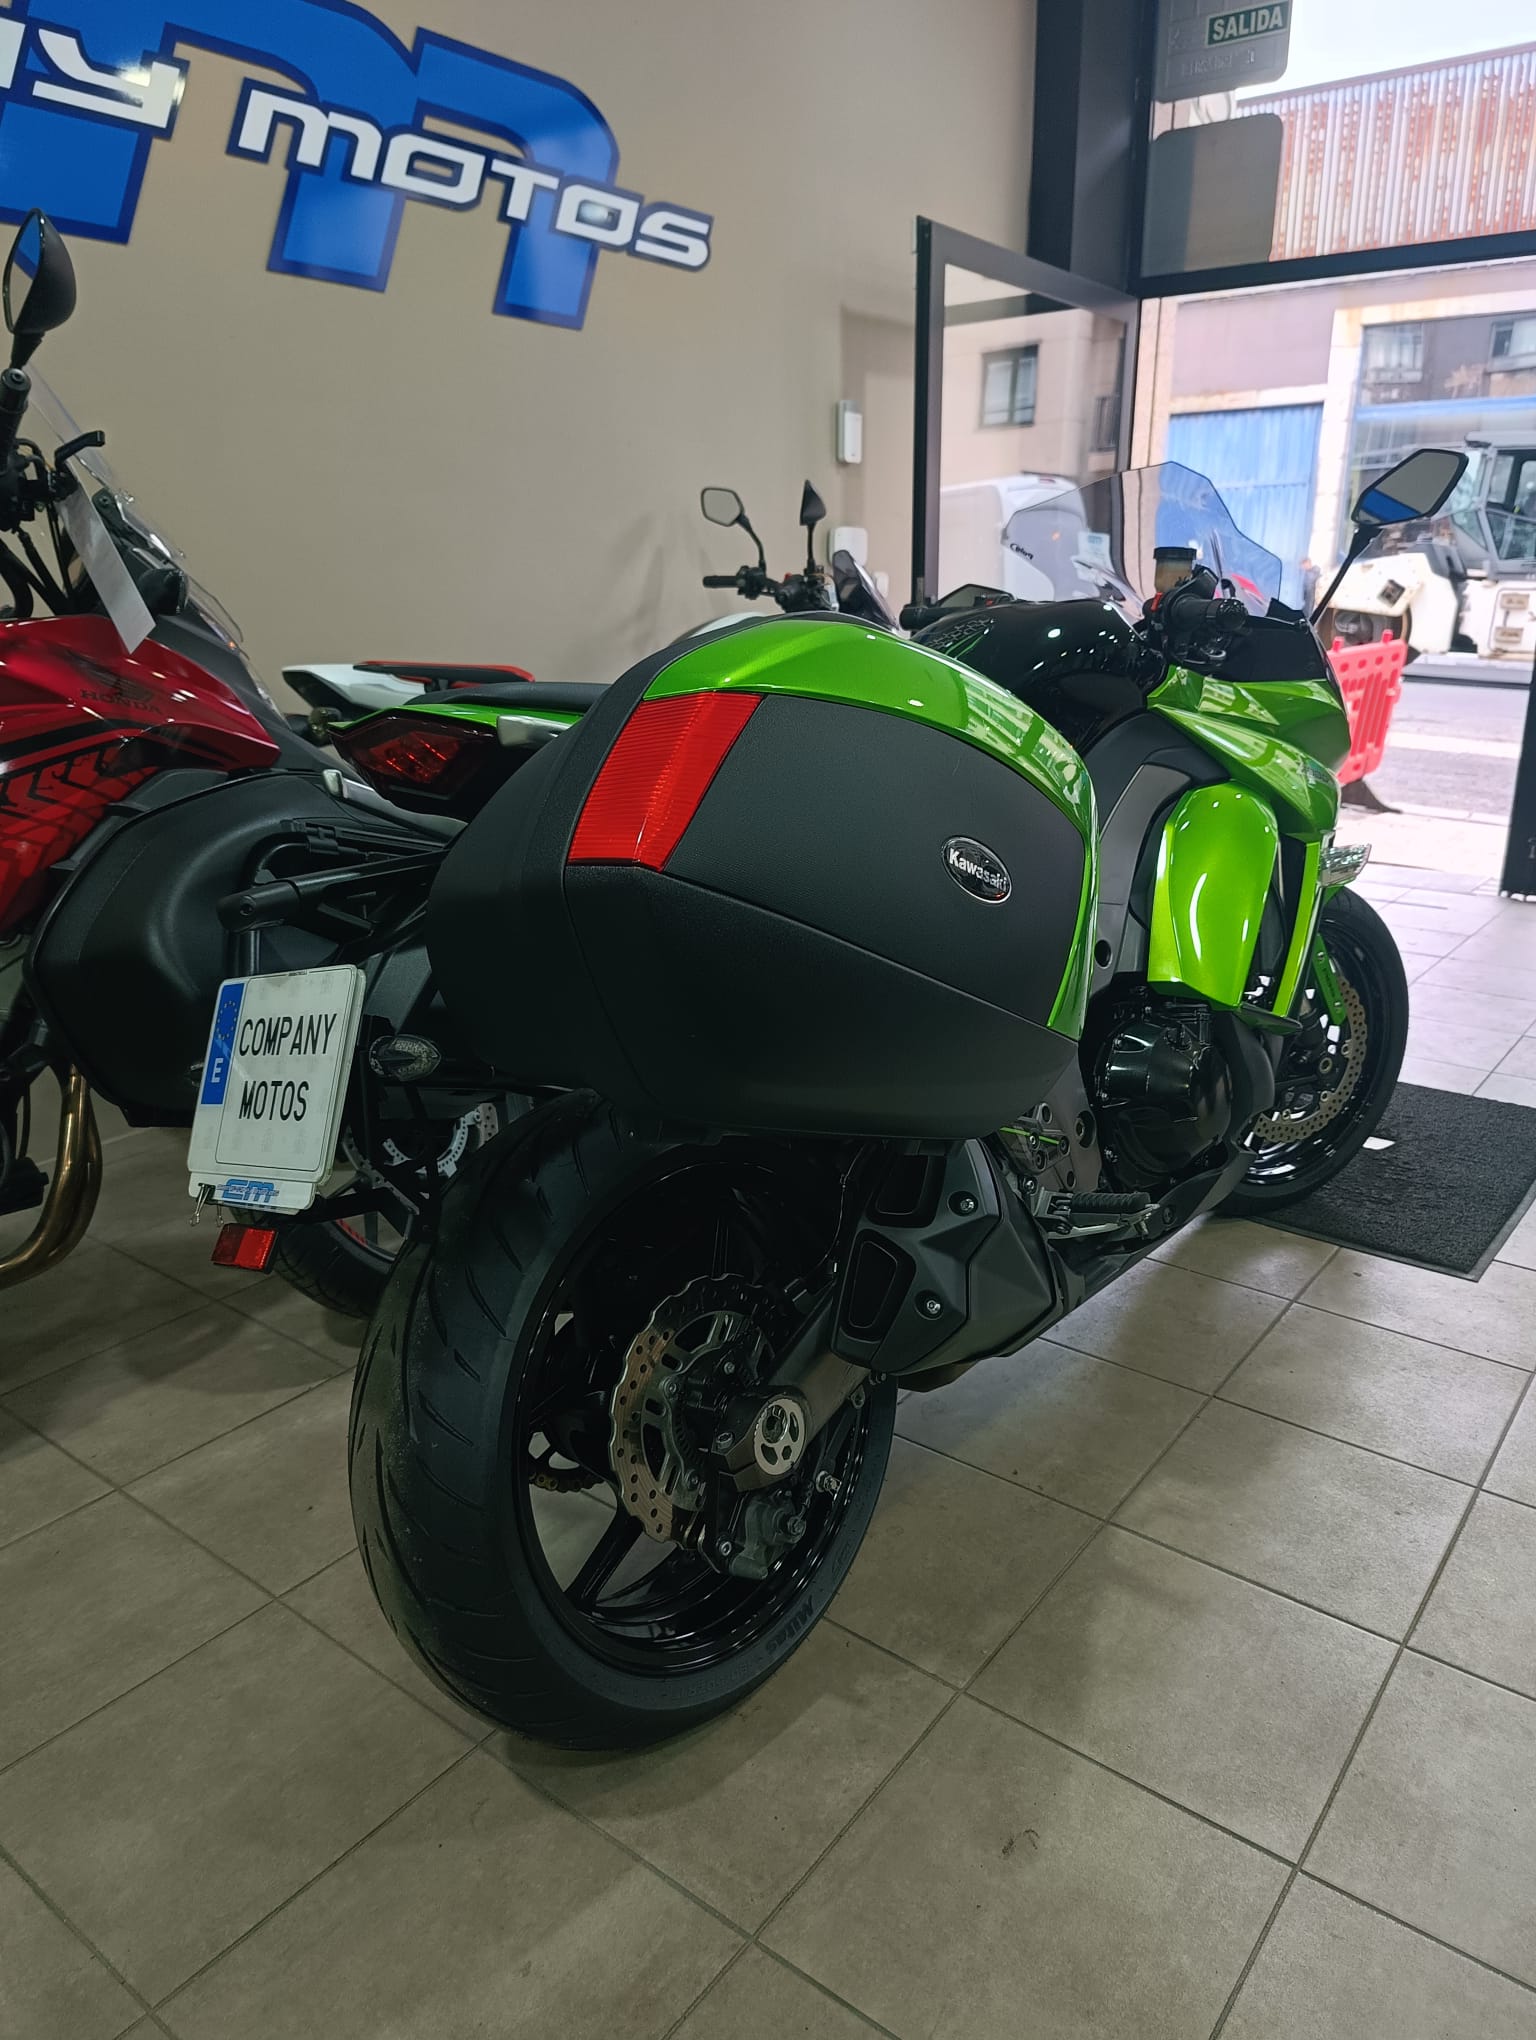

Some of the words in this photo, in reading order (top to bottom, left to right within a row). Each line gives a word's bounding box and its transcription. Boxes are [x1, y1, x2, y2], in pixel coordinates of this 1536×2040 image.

[1213, 6, 1284, 40] SALIDA
[0, 17, 184, 129] Y
[80, 688, 162, 715] HONDA
[948, 847, 1008, 892] Kawasaki
[239, 1013, 338, 1057] COMPANY
[210, 1057, 224, 1084] E
[238, 1080, 310, 1122] MOTOS
